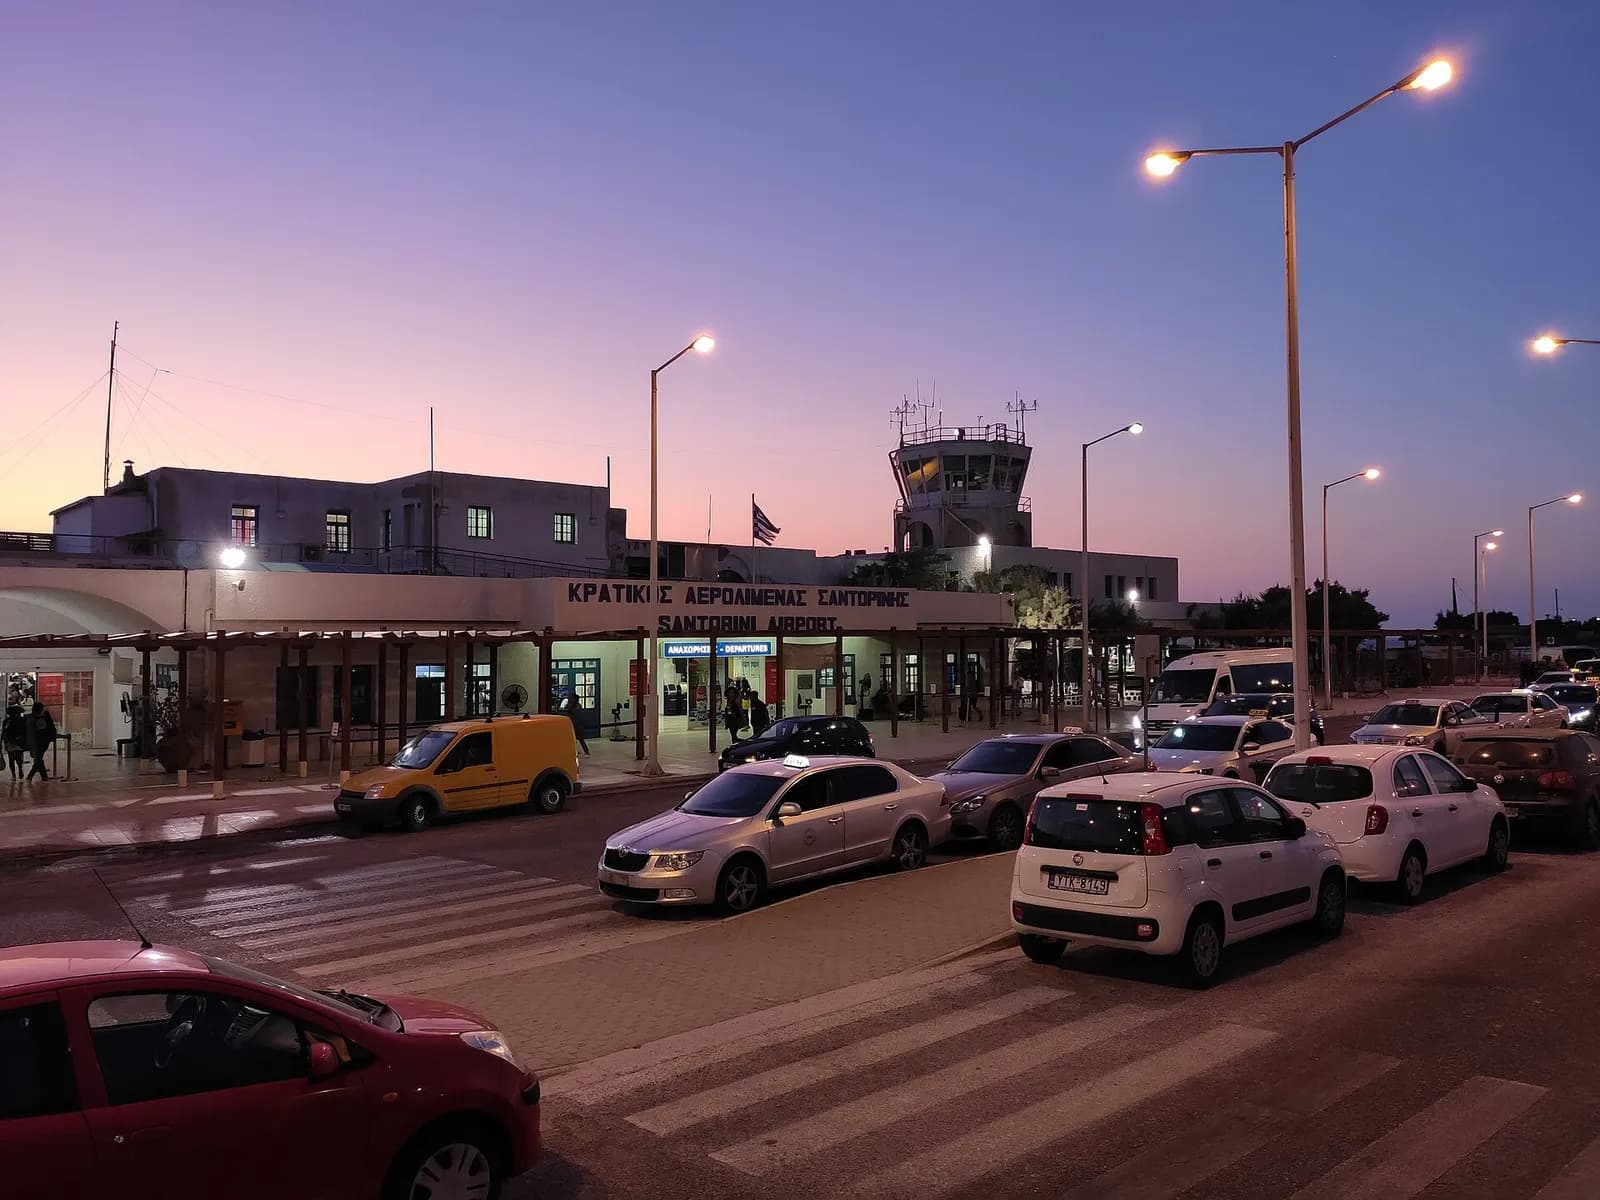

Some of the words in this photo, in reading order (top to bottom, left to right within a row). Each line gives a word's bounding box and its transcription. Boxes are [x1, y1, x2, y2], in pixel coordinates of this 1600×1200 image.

[685, 586, 807, 607] ΑΕΡΟΛΙΜΕΝΑΣ
[817, 589, 910, 608] ΣΑΝΤΟΡΙΝΗΣ
[657, 615, 757, 633] SANTORINI
[768, 615, 838, 632] AIRPORT
[725, 644, 768, 653] DEPARTURES
